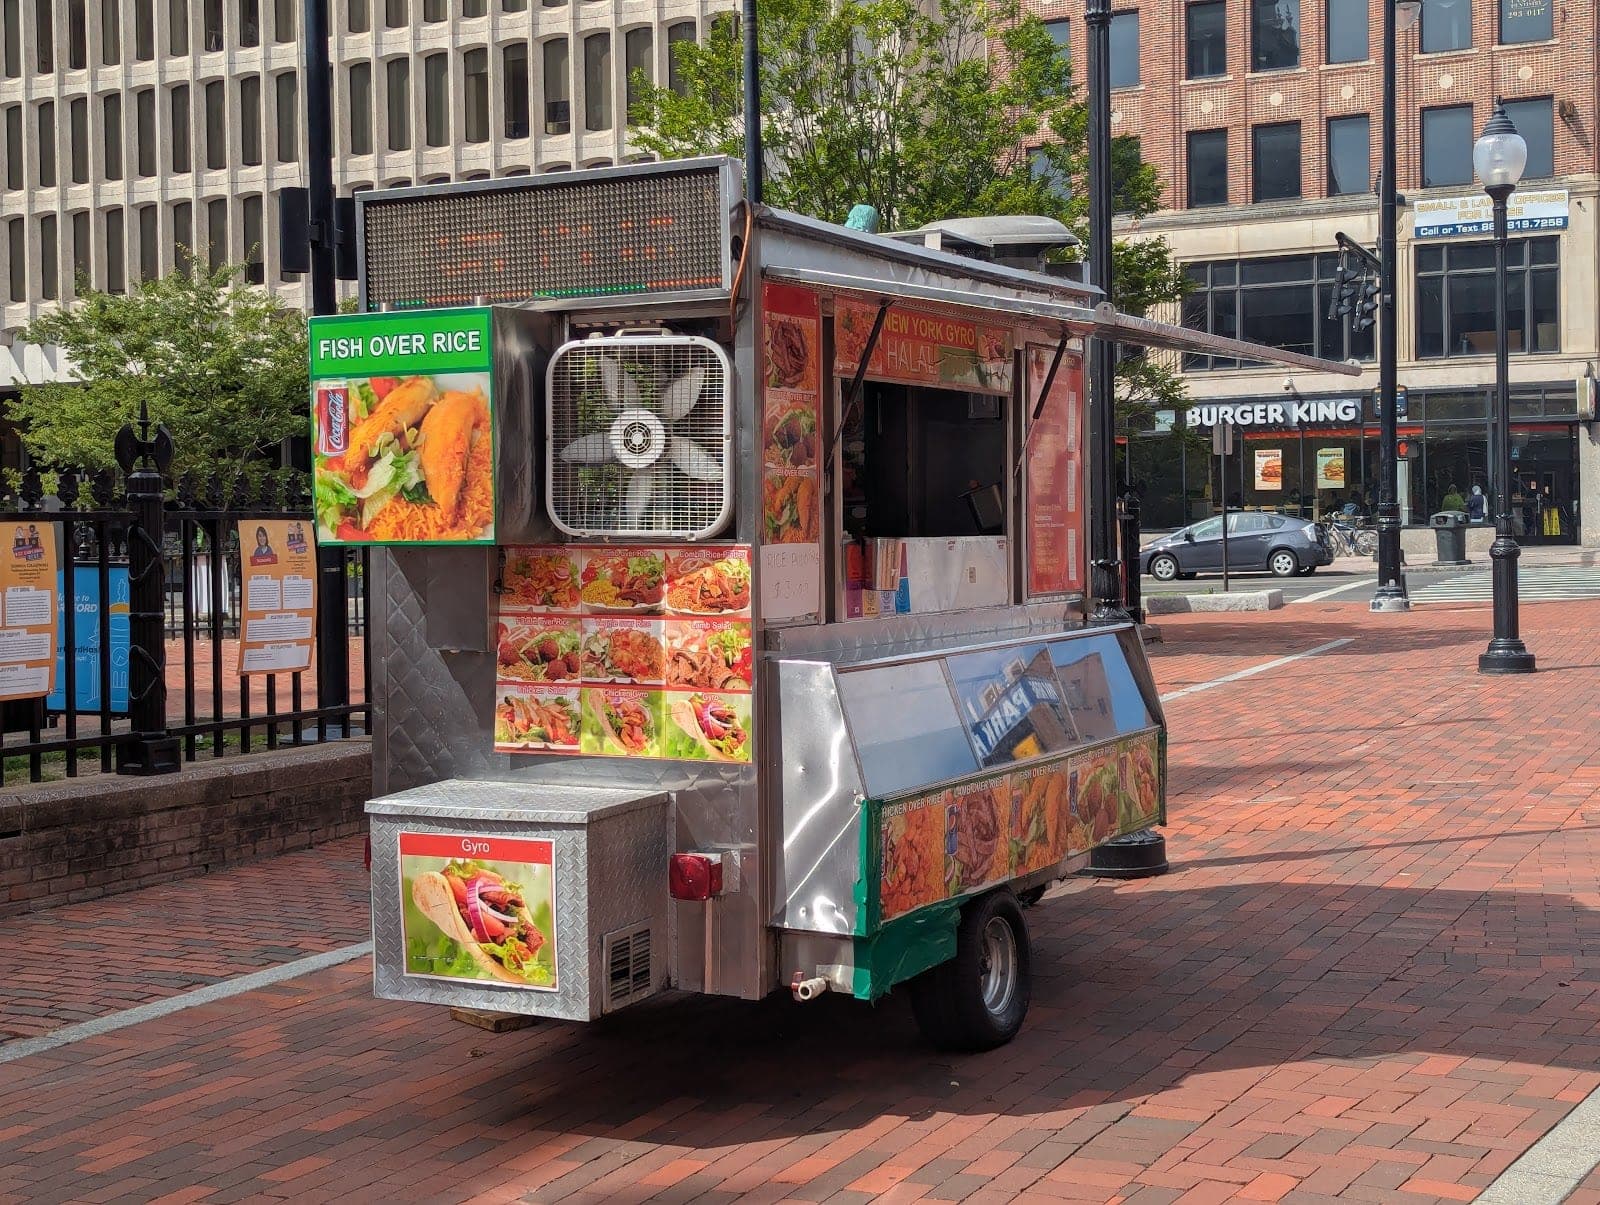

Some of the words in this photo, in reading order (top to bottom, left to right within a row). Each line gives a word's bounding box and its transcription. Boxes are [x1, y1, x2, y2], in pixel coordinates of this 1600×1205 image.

[1417, 203, 1457, 212] SMALL
[1515, 193, 1566, 205] OFFICES
[1458, 210, 1481, 220] FOR
[1420, 227, 1439, 236] Call
[1456, 225, 1478, 233] Text
[884, 312, 909, 334] NEW
[912, 317, 943, 340] YORK
[946, 325, 975, 345] GYRO
[319, 337, 363, 360] FISH
[370, 333, 426, 357] OVER
[433, 330, 481, 353] RICE
[1186, 403, 1284, 427] BURGER
[1292, 400, 1356, 423] KING
[691, 621, 711, 630] Lamb
[712, 621, 733, 630] Salad
[633, 690, 649, 700] Gyro
[703, 693, 719, 702] Gyro
[882, 802, 907, 818] HICKEN
[909, 798, 925, 812] OVER
[461, 839, 490, 855] Gyro
